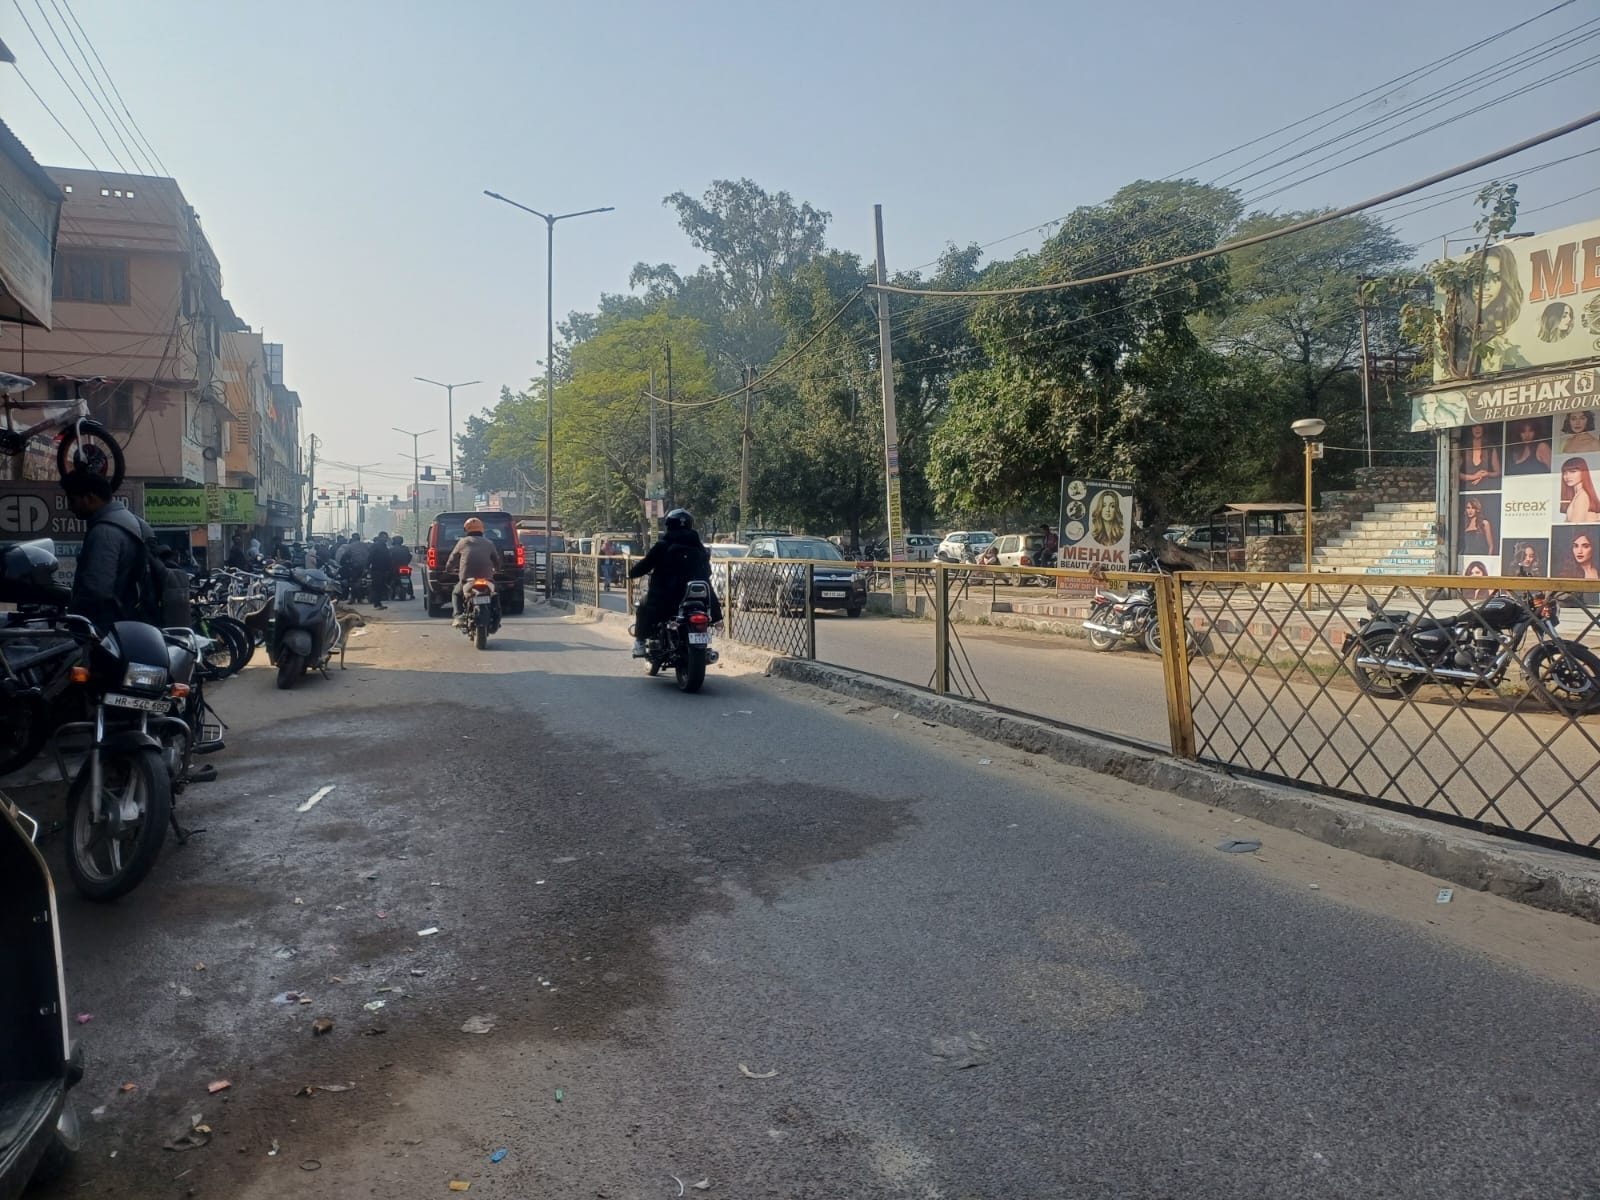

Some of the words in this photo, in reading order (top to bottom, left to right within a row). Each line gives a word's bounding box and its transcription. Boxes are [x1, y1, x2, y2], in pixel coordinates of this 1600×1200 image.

[1480, 380, 1571, 408] MEHAK
[1484, 402, 1537, 420] BEAUTY
[1537, 394, 1600, 414] PARLOUR
[1505, 500, 1546, 512] streax
[52, 518, 88, 532] STATI
[1063, 546, 1124, 563] MEHAK
[1060, 561, 1089, 570] BEAUTY
